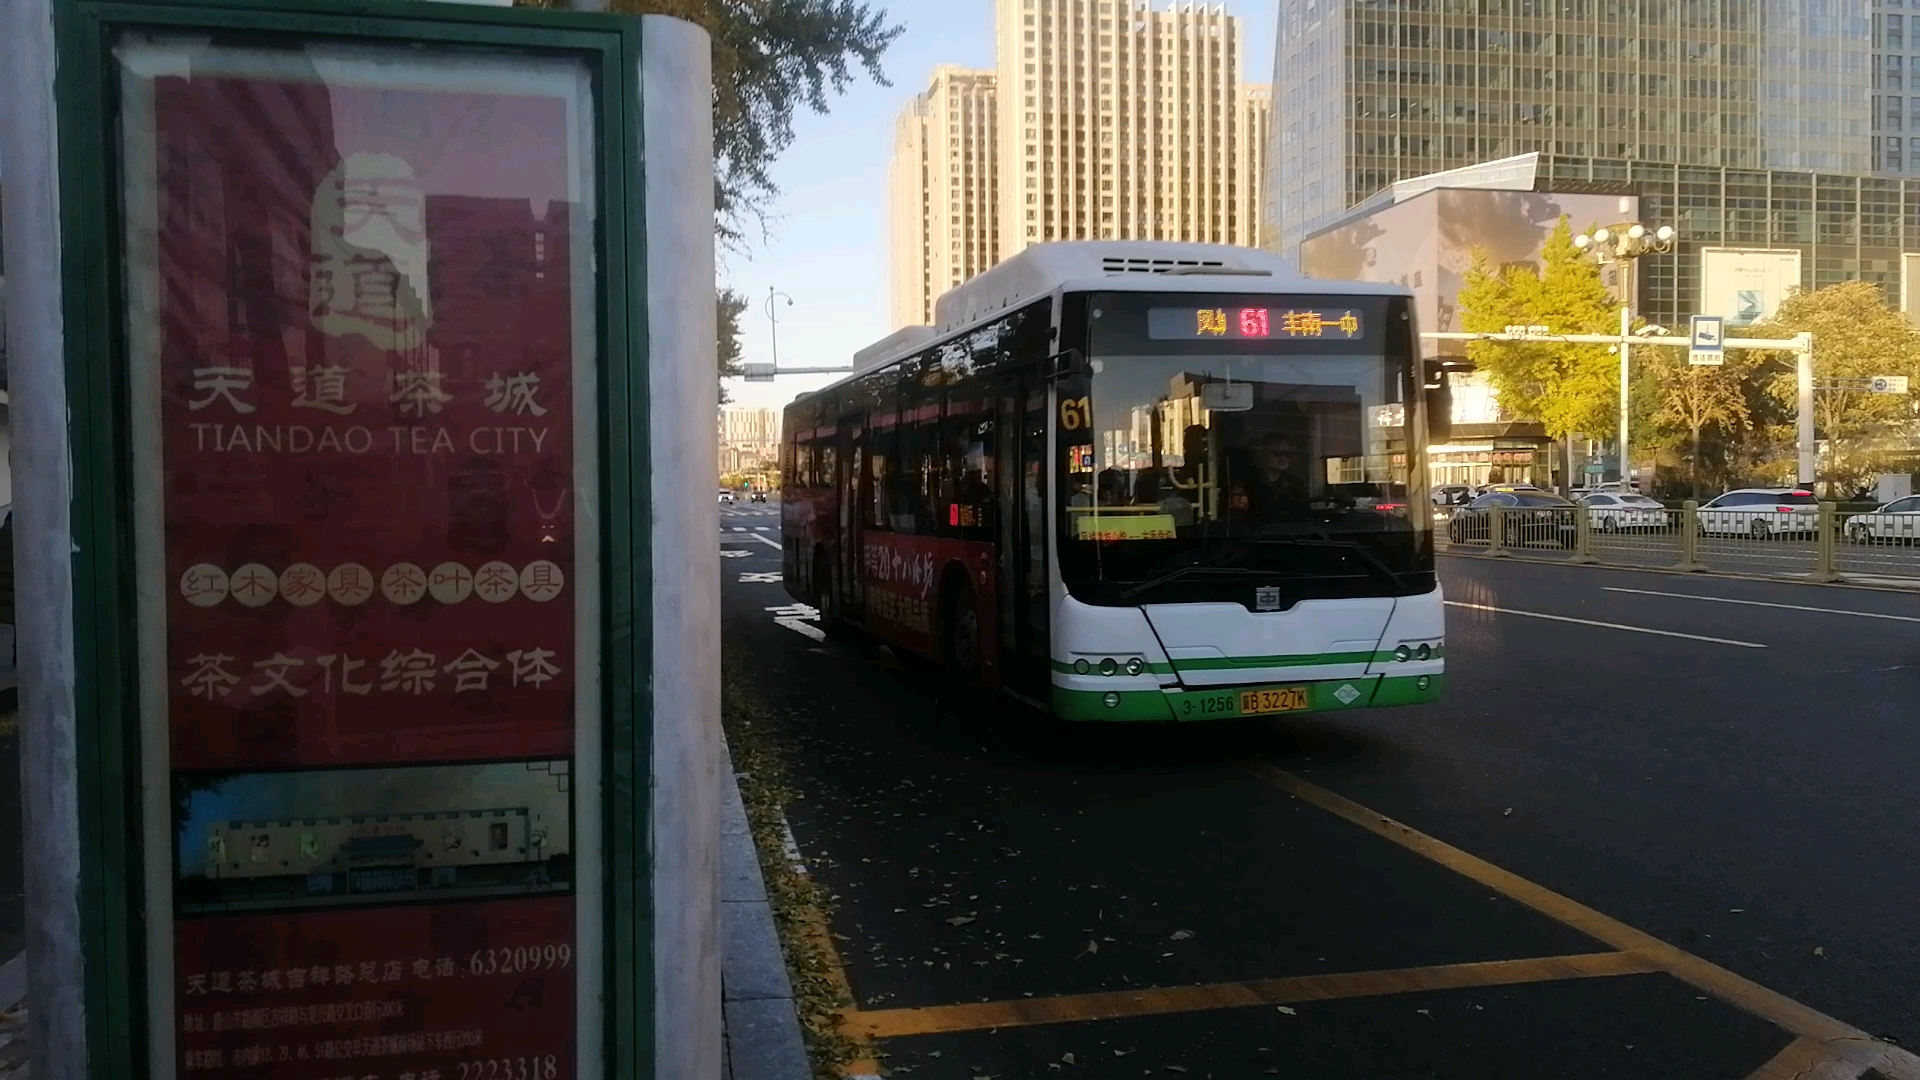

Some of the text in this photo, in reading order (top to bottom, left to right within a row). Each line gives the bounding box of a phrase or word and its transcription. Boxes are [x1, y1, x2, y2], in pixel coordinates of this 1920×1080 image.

[1239, 308, 1270, 337] 61
[187, 365, 550, 417] 天道茶城
[1061, 396, 1092, 430] 61
[188, 421, 550, 455] TIANDAO TEA CITY
[183, 561, 563, 604] 红木家具 茶叶茶具
[181, 646, 563, 701] 茶文化综合体
[1183, 696, 1234, 715] 3-1256
[469, 943, 572, 976] 6320999
